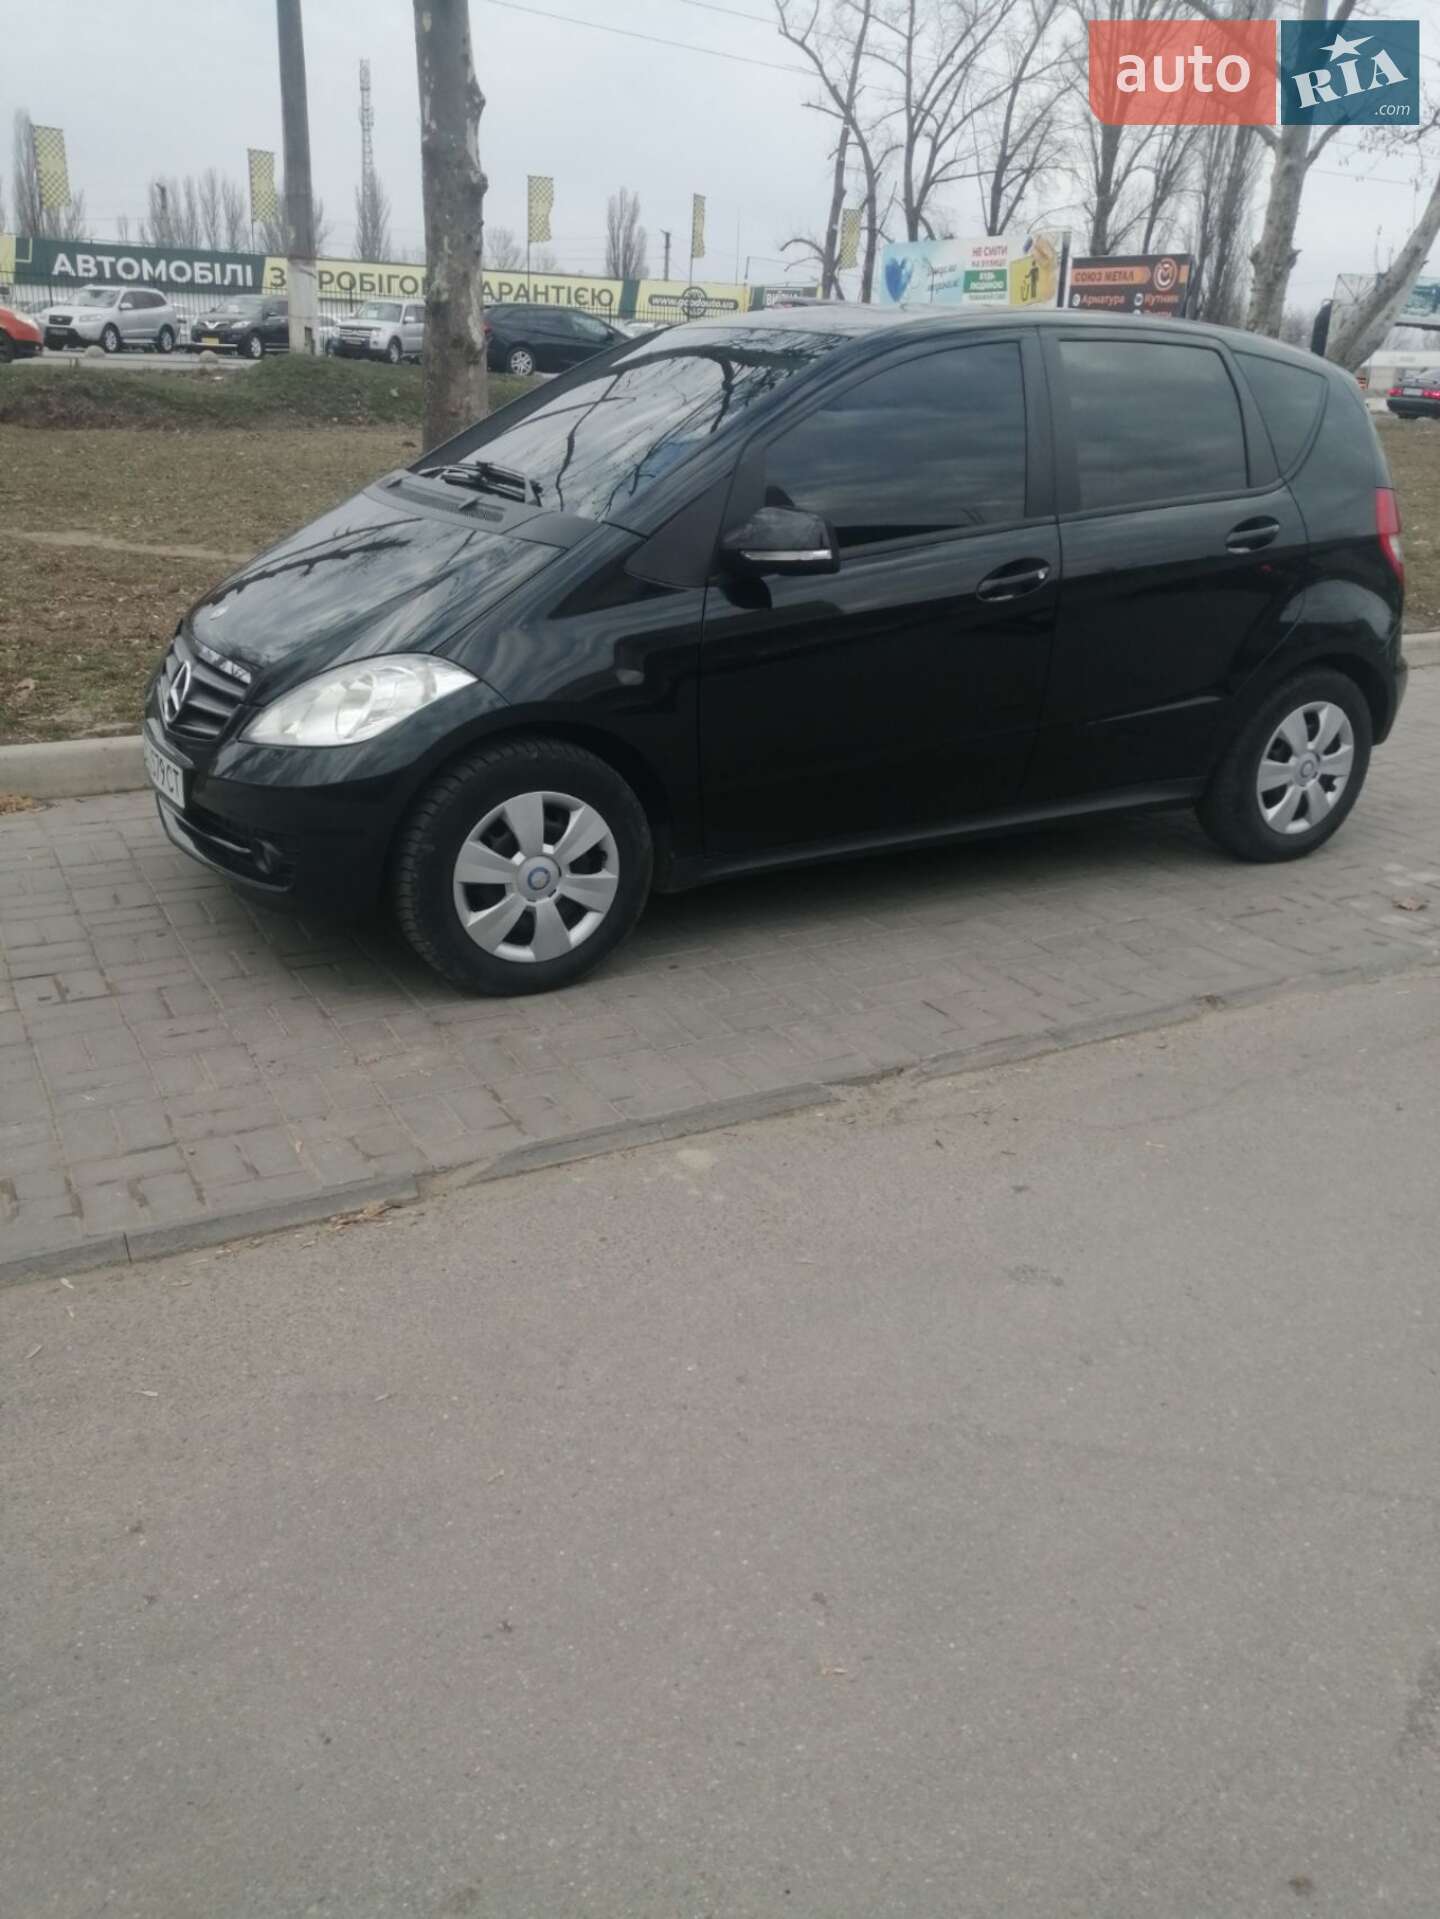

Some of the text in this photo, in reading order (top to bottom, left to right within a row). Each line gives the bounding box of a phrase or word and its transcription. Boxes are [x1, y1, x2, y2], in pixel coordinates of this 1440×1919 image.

[52, 253, 254, 288] АВТОМОБІЛІ
[318, 270, 427, 296] РОБІГО
[481, 280, 614, 307] АРАНТІЄЮ
[1074, 271, 1103, 282] СОЮЗ
